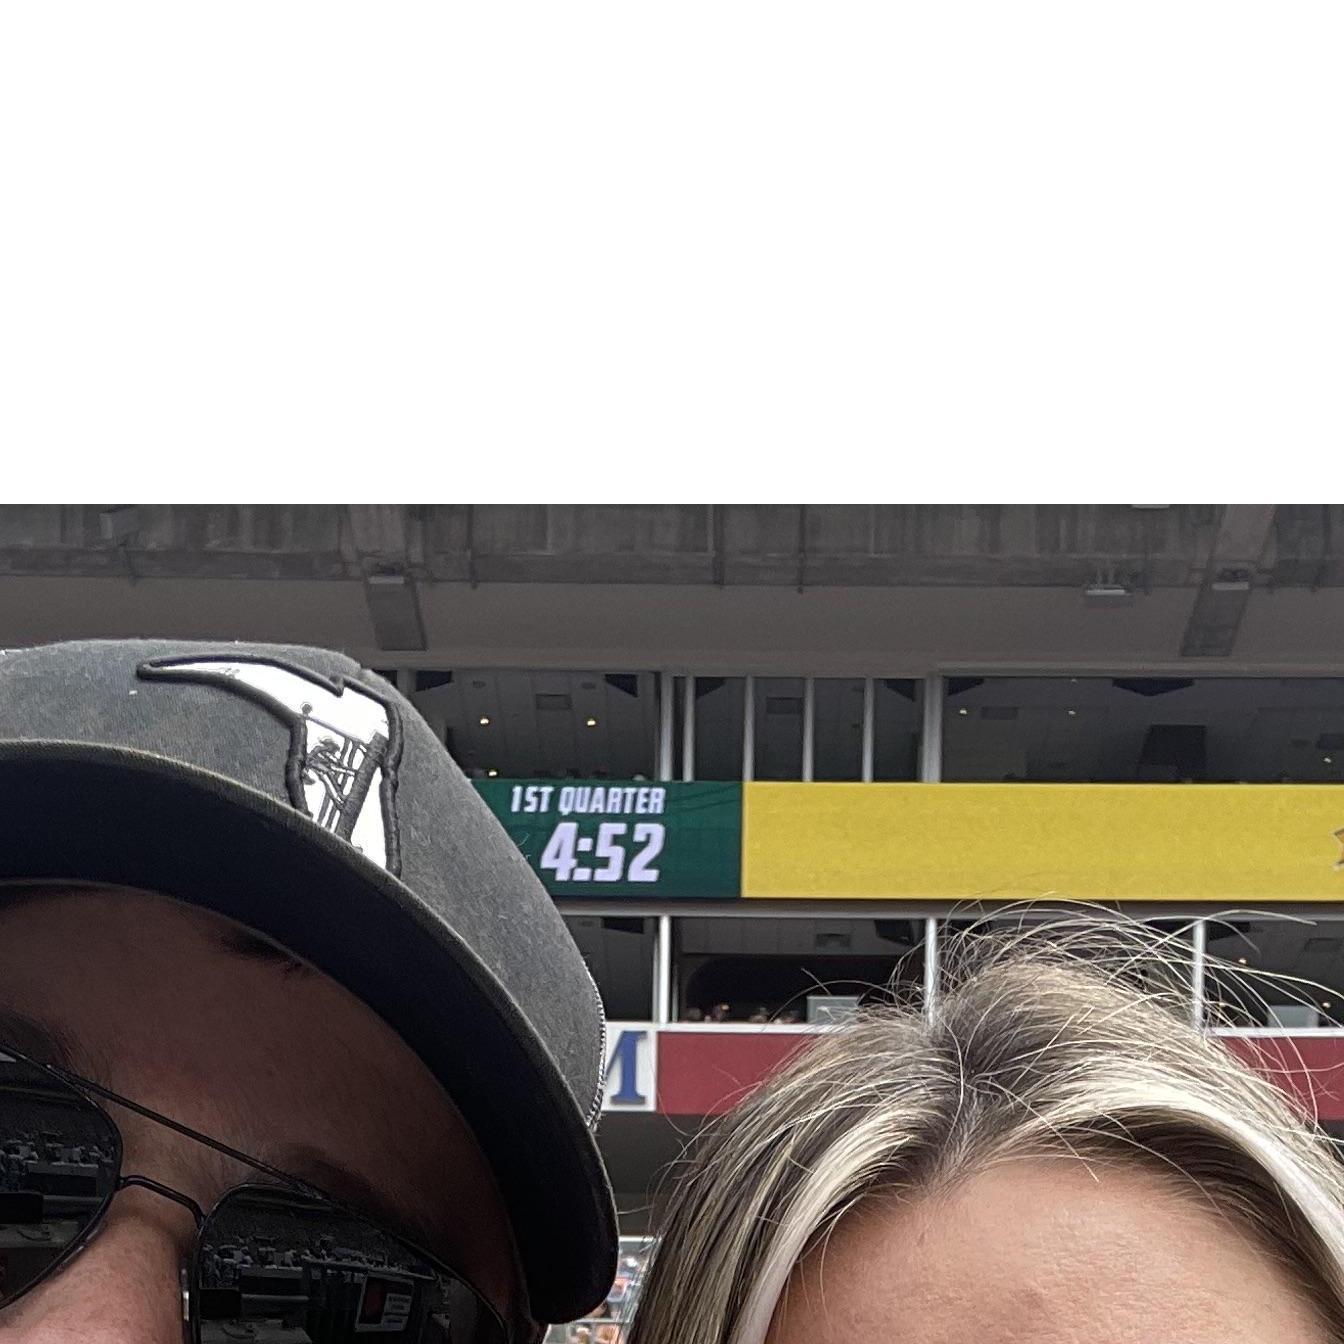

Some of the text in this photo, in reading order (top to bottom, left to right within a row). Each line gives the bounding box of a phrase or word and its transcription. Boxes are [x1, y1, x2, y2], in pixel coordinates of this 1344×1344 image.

[511, 786, 666, 815] 1ST QUARTER
[540, 822, 665, 882] 4:52
